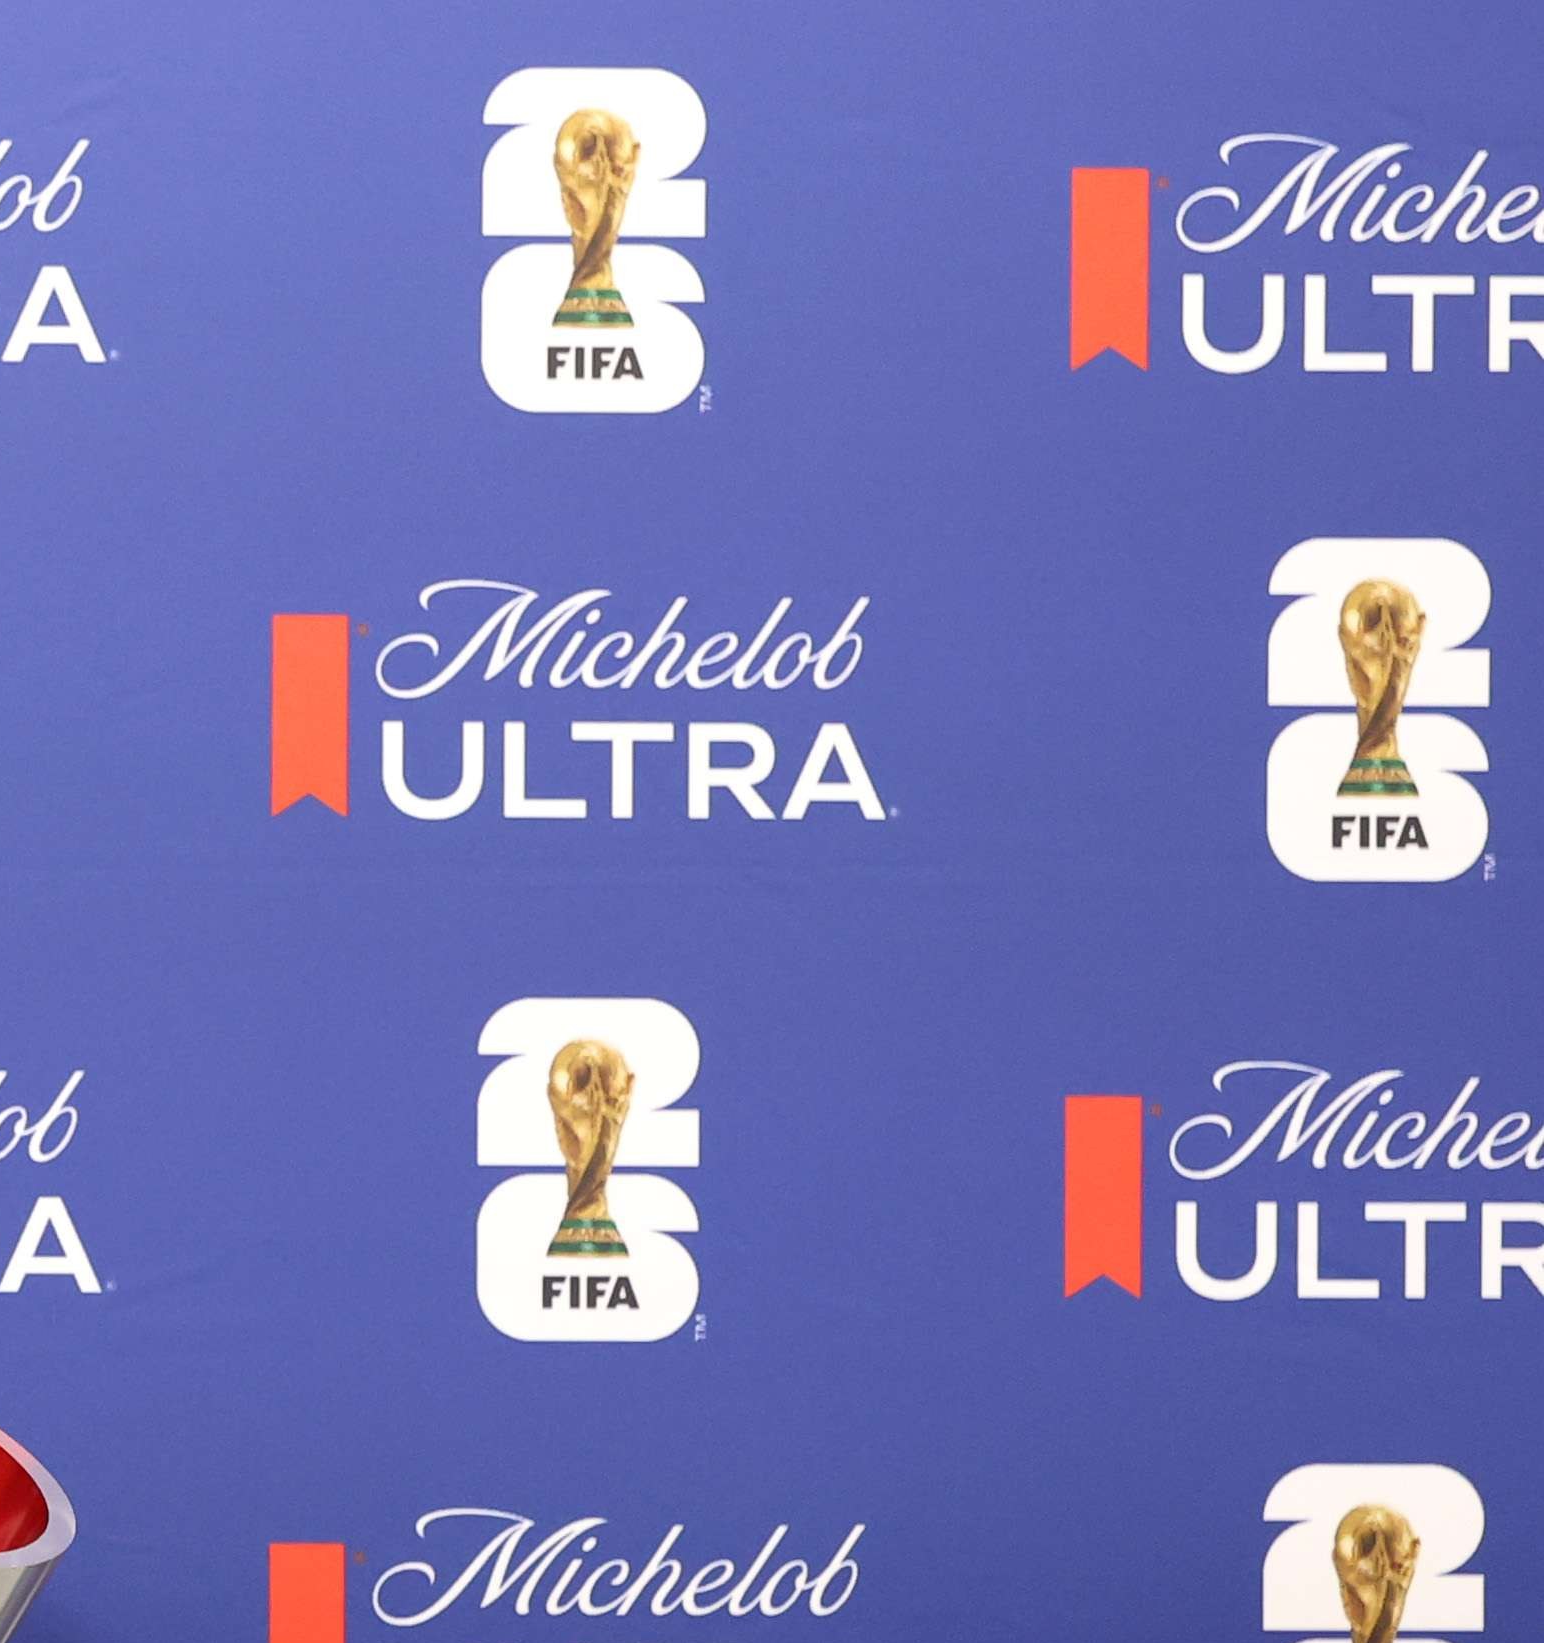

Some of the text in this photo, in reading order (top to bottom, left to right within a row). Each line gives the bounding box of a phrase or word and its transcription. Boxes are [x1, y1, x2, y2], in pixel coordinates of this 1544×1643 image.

[1176, 134, 1544, 252] Miche
[548, 348, 642, 378] FIFA
[376, 580, 869, 698] Michelob
[382, 721, 885, 820] ULTRA
[1333, 817, 1427, 847] FIFA
[1169, 1061, 1544, 1179] Miche
[543, 1277, 638, 1308] FIFA
[373, 1508, 865, 1626] Michelob
